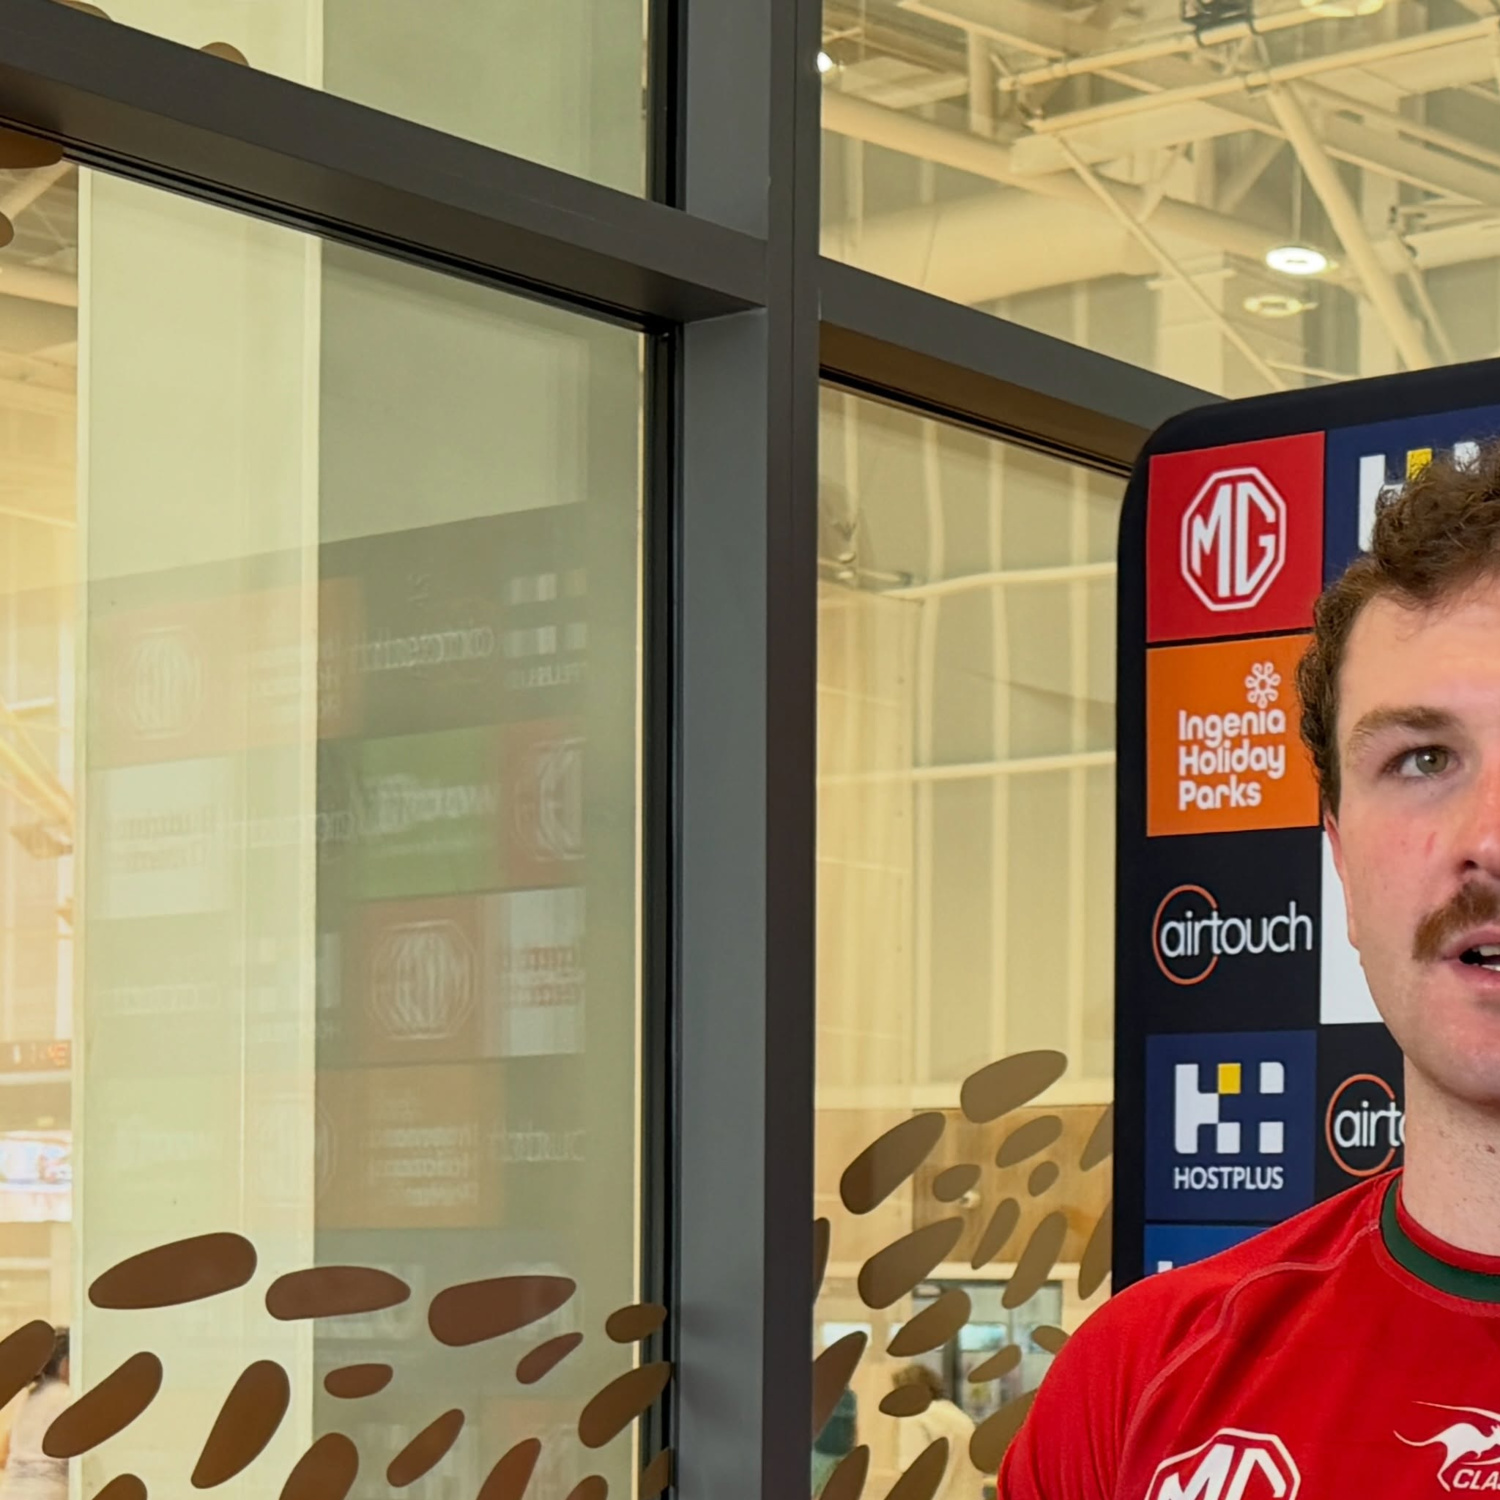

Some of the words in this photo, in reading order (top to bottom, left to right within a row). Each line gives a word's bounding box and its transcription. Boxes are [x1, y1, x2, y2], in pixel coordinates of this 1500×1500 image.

[1178, 705, 1287, 746] Ingenia
[1178, 739, 1286, 782] Holiday
[1178, 774, 1263, 812] Parks
[1160, 901, 1313, 958] airtouch
[1333, 1100, 1406, 1148] airt
[1174, 1165, 1285, 1191] HOSTPLUS
